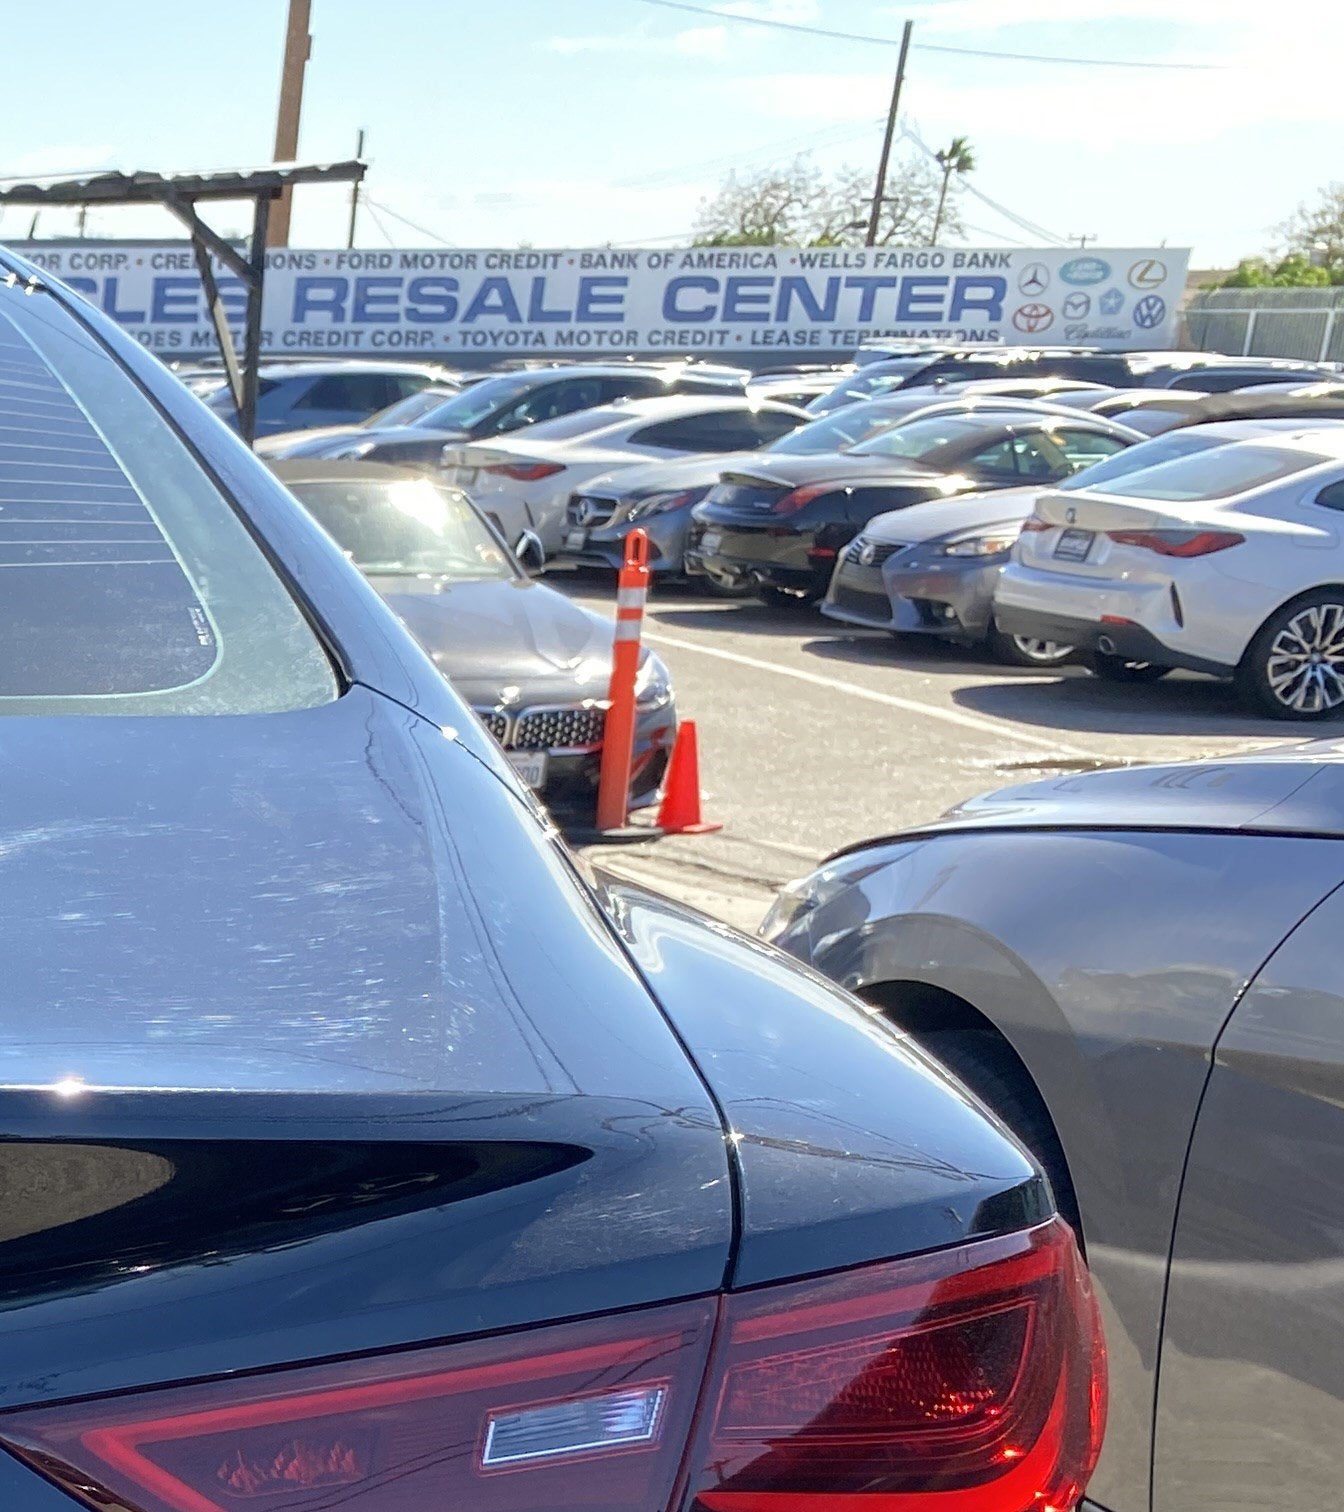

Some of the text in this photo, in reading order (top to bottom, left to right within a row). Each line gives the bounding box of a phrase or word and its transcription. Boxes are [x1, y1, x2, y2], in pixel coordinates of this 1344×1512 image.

[69, 253, 130, 270] CORP.
[336, 252, 392, 270] FORD
[400, 252, 477, 270] MOTOR
[485, 252, 563, 270] CREDIT
[579, 252, 639, 269] BANK
[647, 252, 674, 269] OF
[679, 252, 778, 269] AMERICA
[799, 252, 868, 269] WELLS
[873, 252, 945, 269] FARGO
[952, 252, 1012, 269] BANK
[291, 276, 629, 324] RESALE
[662, 275, 1008, 323] CENTER
[134, 331, 183, 348] DES
[282, 330, 363, 348] CREDIT
[371, 330, 436, 348] CORP.
[461, 330, 547, 348] TOYOTA
[554, 330, 639, 347] MOTOR
[647, 330, 729, 347] CREDIT
[751, 329, 821, 347] LEASE
